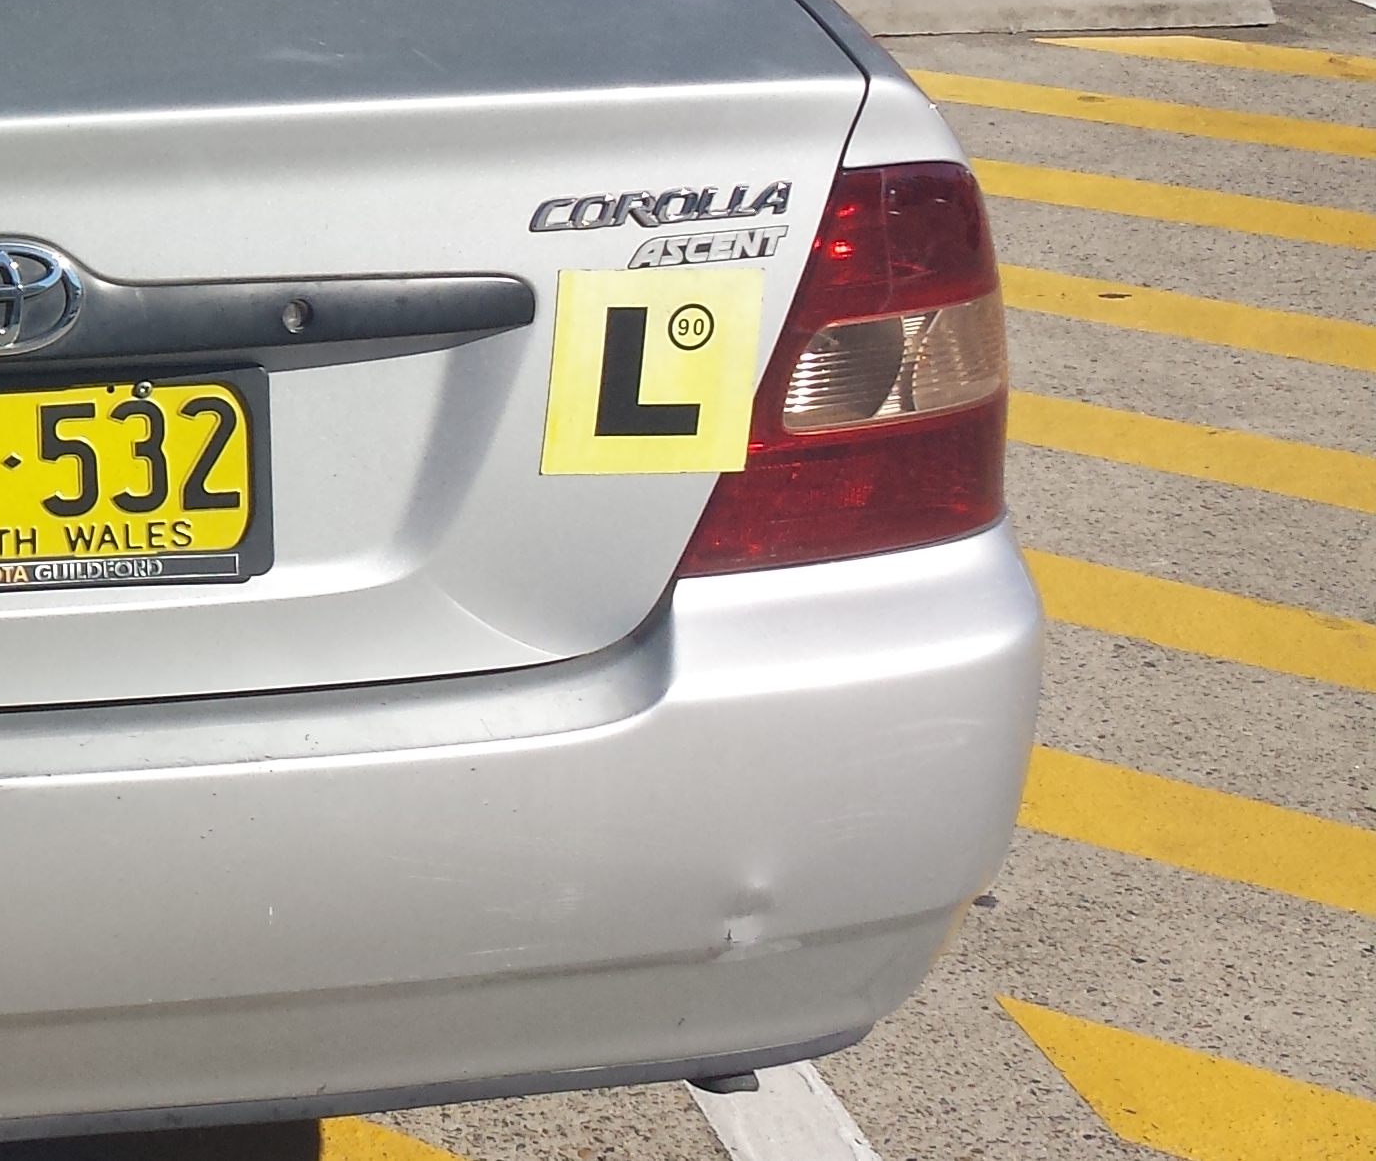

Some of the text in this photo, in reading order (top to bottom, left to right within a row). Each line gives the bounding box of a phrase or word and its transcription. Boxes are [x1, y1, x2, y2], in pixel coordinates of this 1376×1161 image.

[529, 181, 793, 232] COROLLA
[628, 225, 789, 269] ASCENT
[677, 318, 705, 336] 90
[594, 306, 701, 436] L
[63, 519, 194, 554] WALES
[34, 558, 163, 582] GUILDFORD
